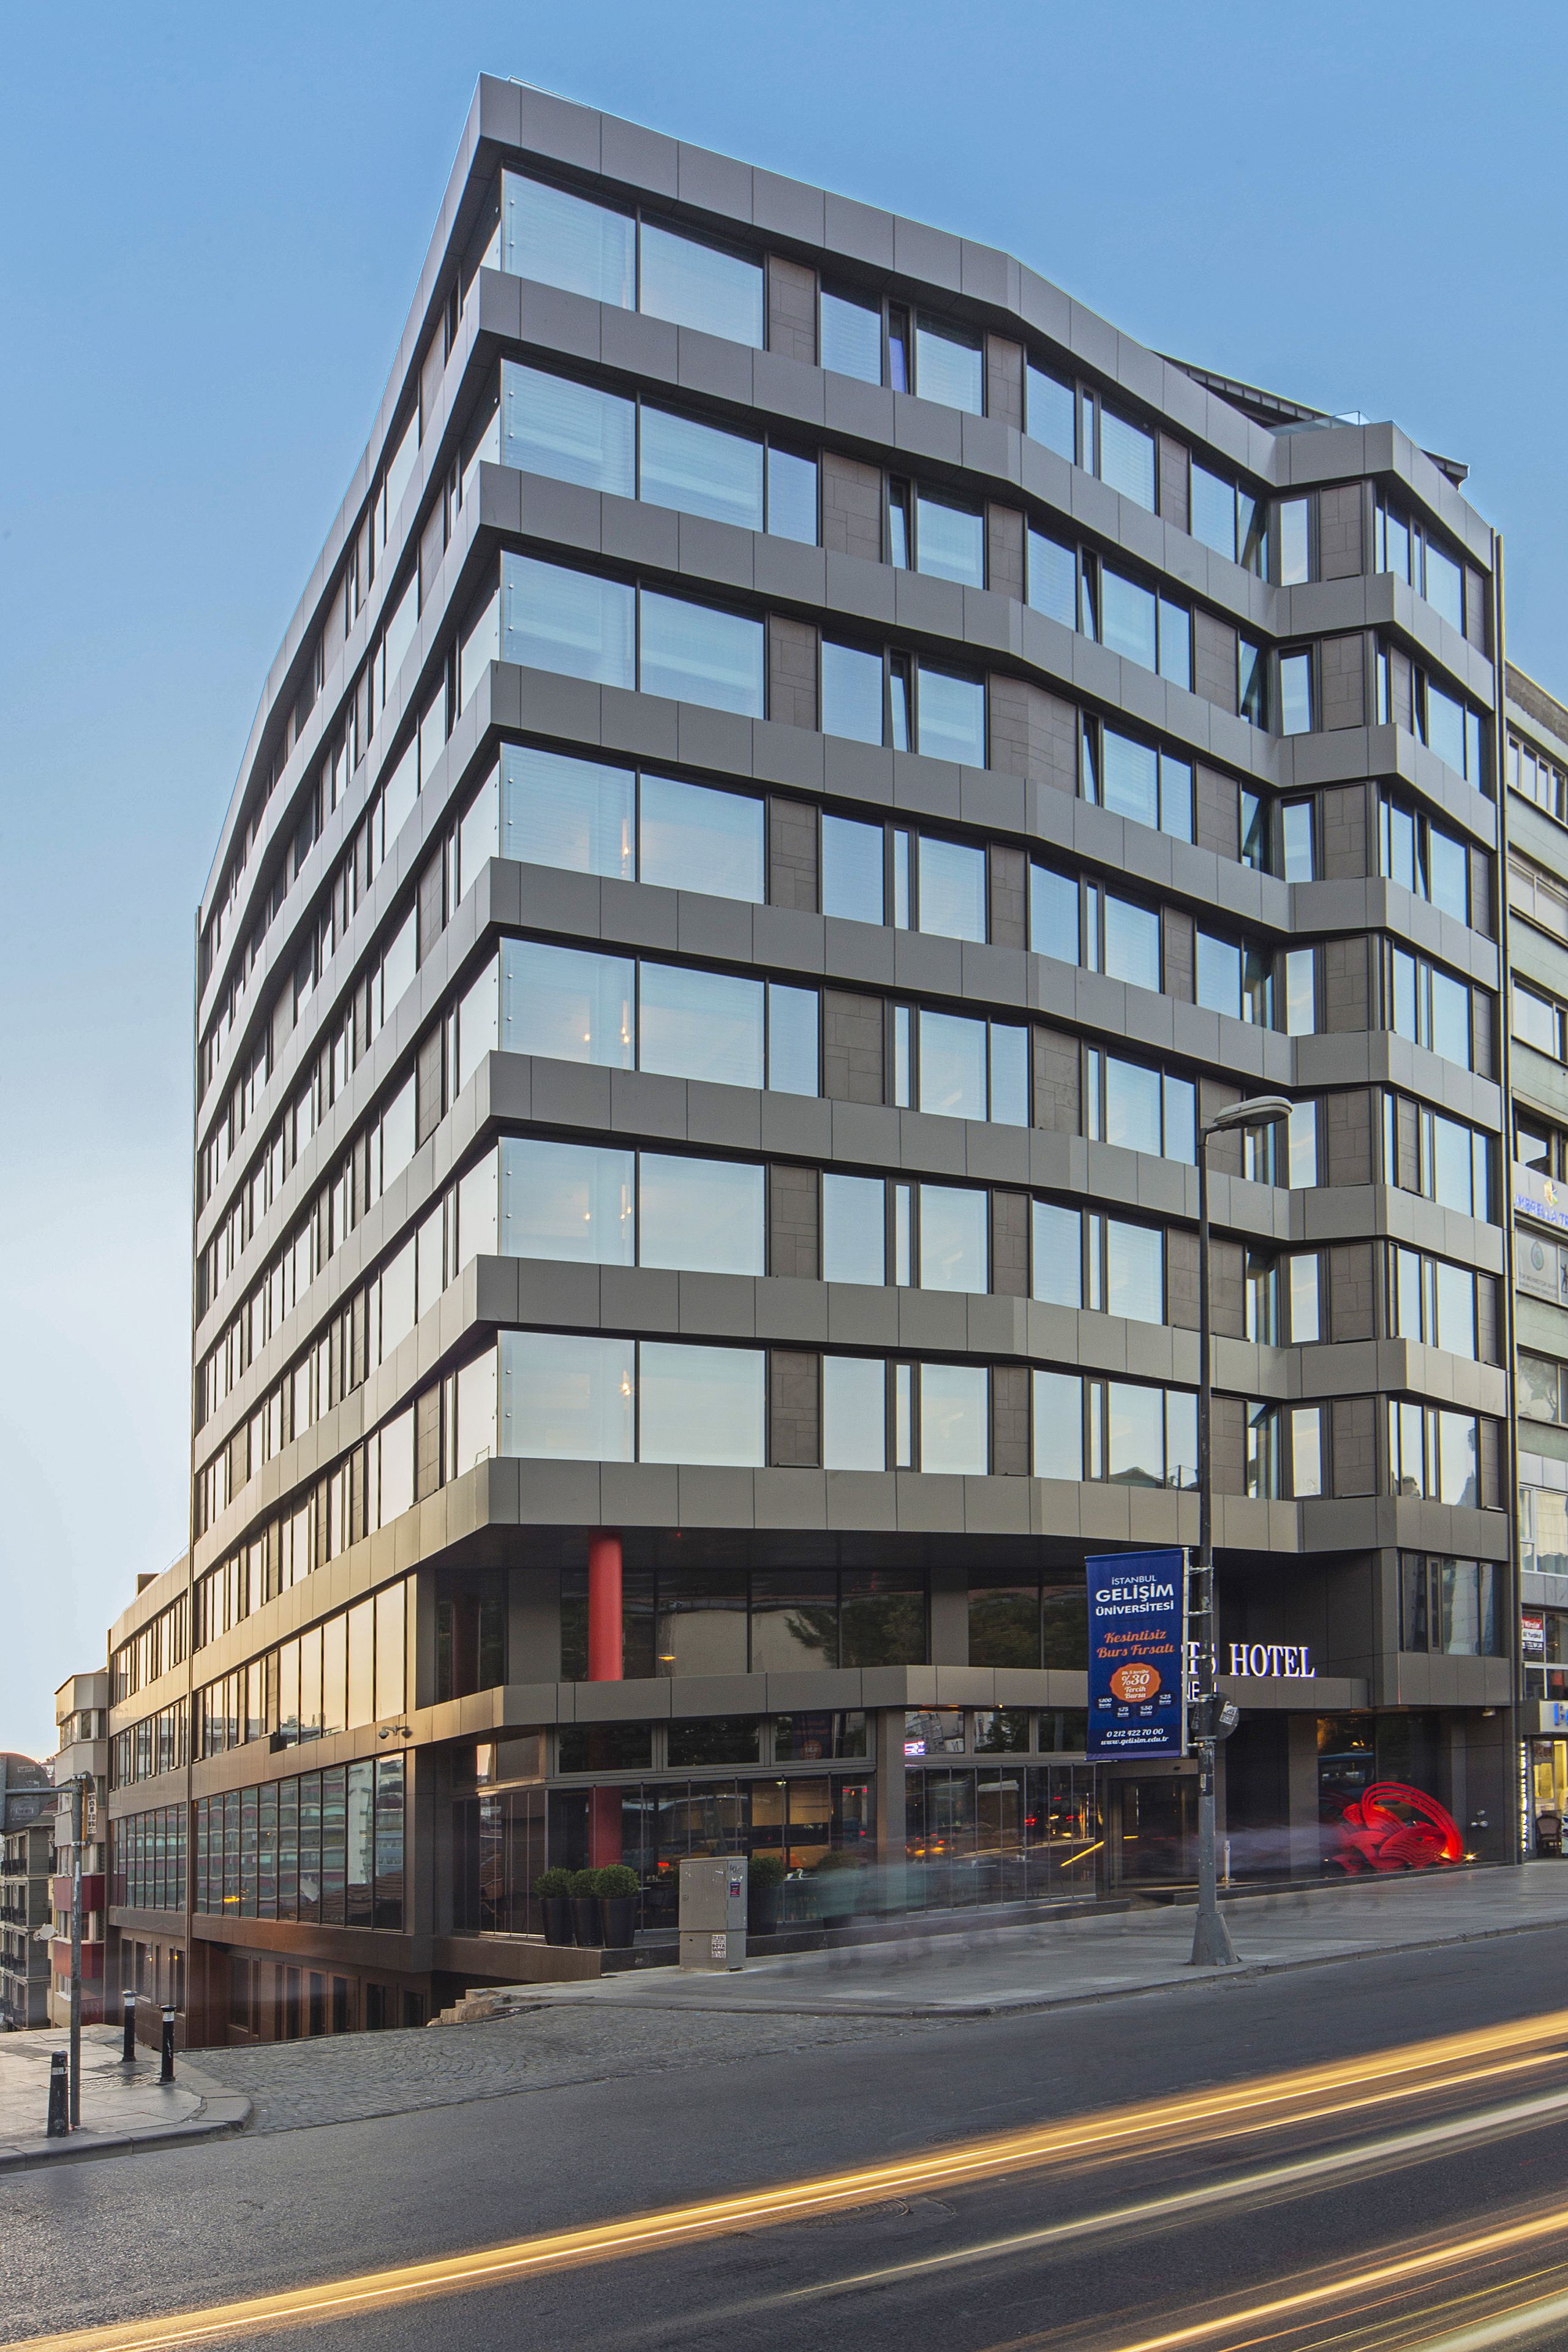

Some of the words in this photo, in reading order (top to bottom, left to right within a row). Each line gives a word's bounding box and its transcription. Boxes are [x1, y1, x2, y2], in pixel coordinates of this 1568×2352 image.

[1112, 1575, 1157, 1585] İSTANBUL
[1095, 1583, 1174, 1602] GELİŞİM
[1095, 1600, 1174, 1616] ÜNİVERSİTESİ
[1104, 1629, 1167, 1643] Kesintisiz
[1096, 1646, 1128, 1658] Burs
[1131, 1643, 1175, 1656] Fırsatı
[1229, 1643, 1316, 1678] HOTEL
[1121, 1673, 1150, 1686] %30
[1101, 1736, 1169, 1746] www.gelisim.edu.tr
